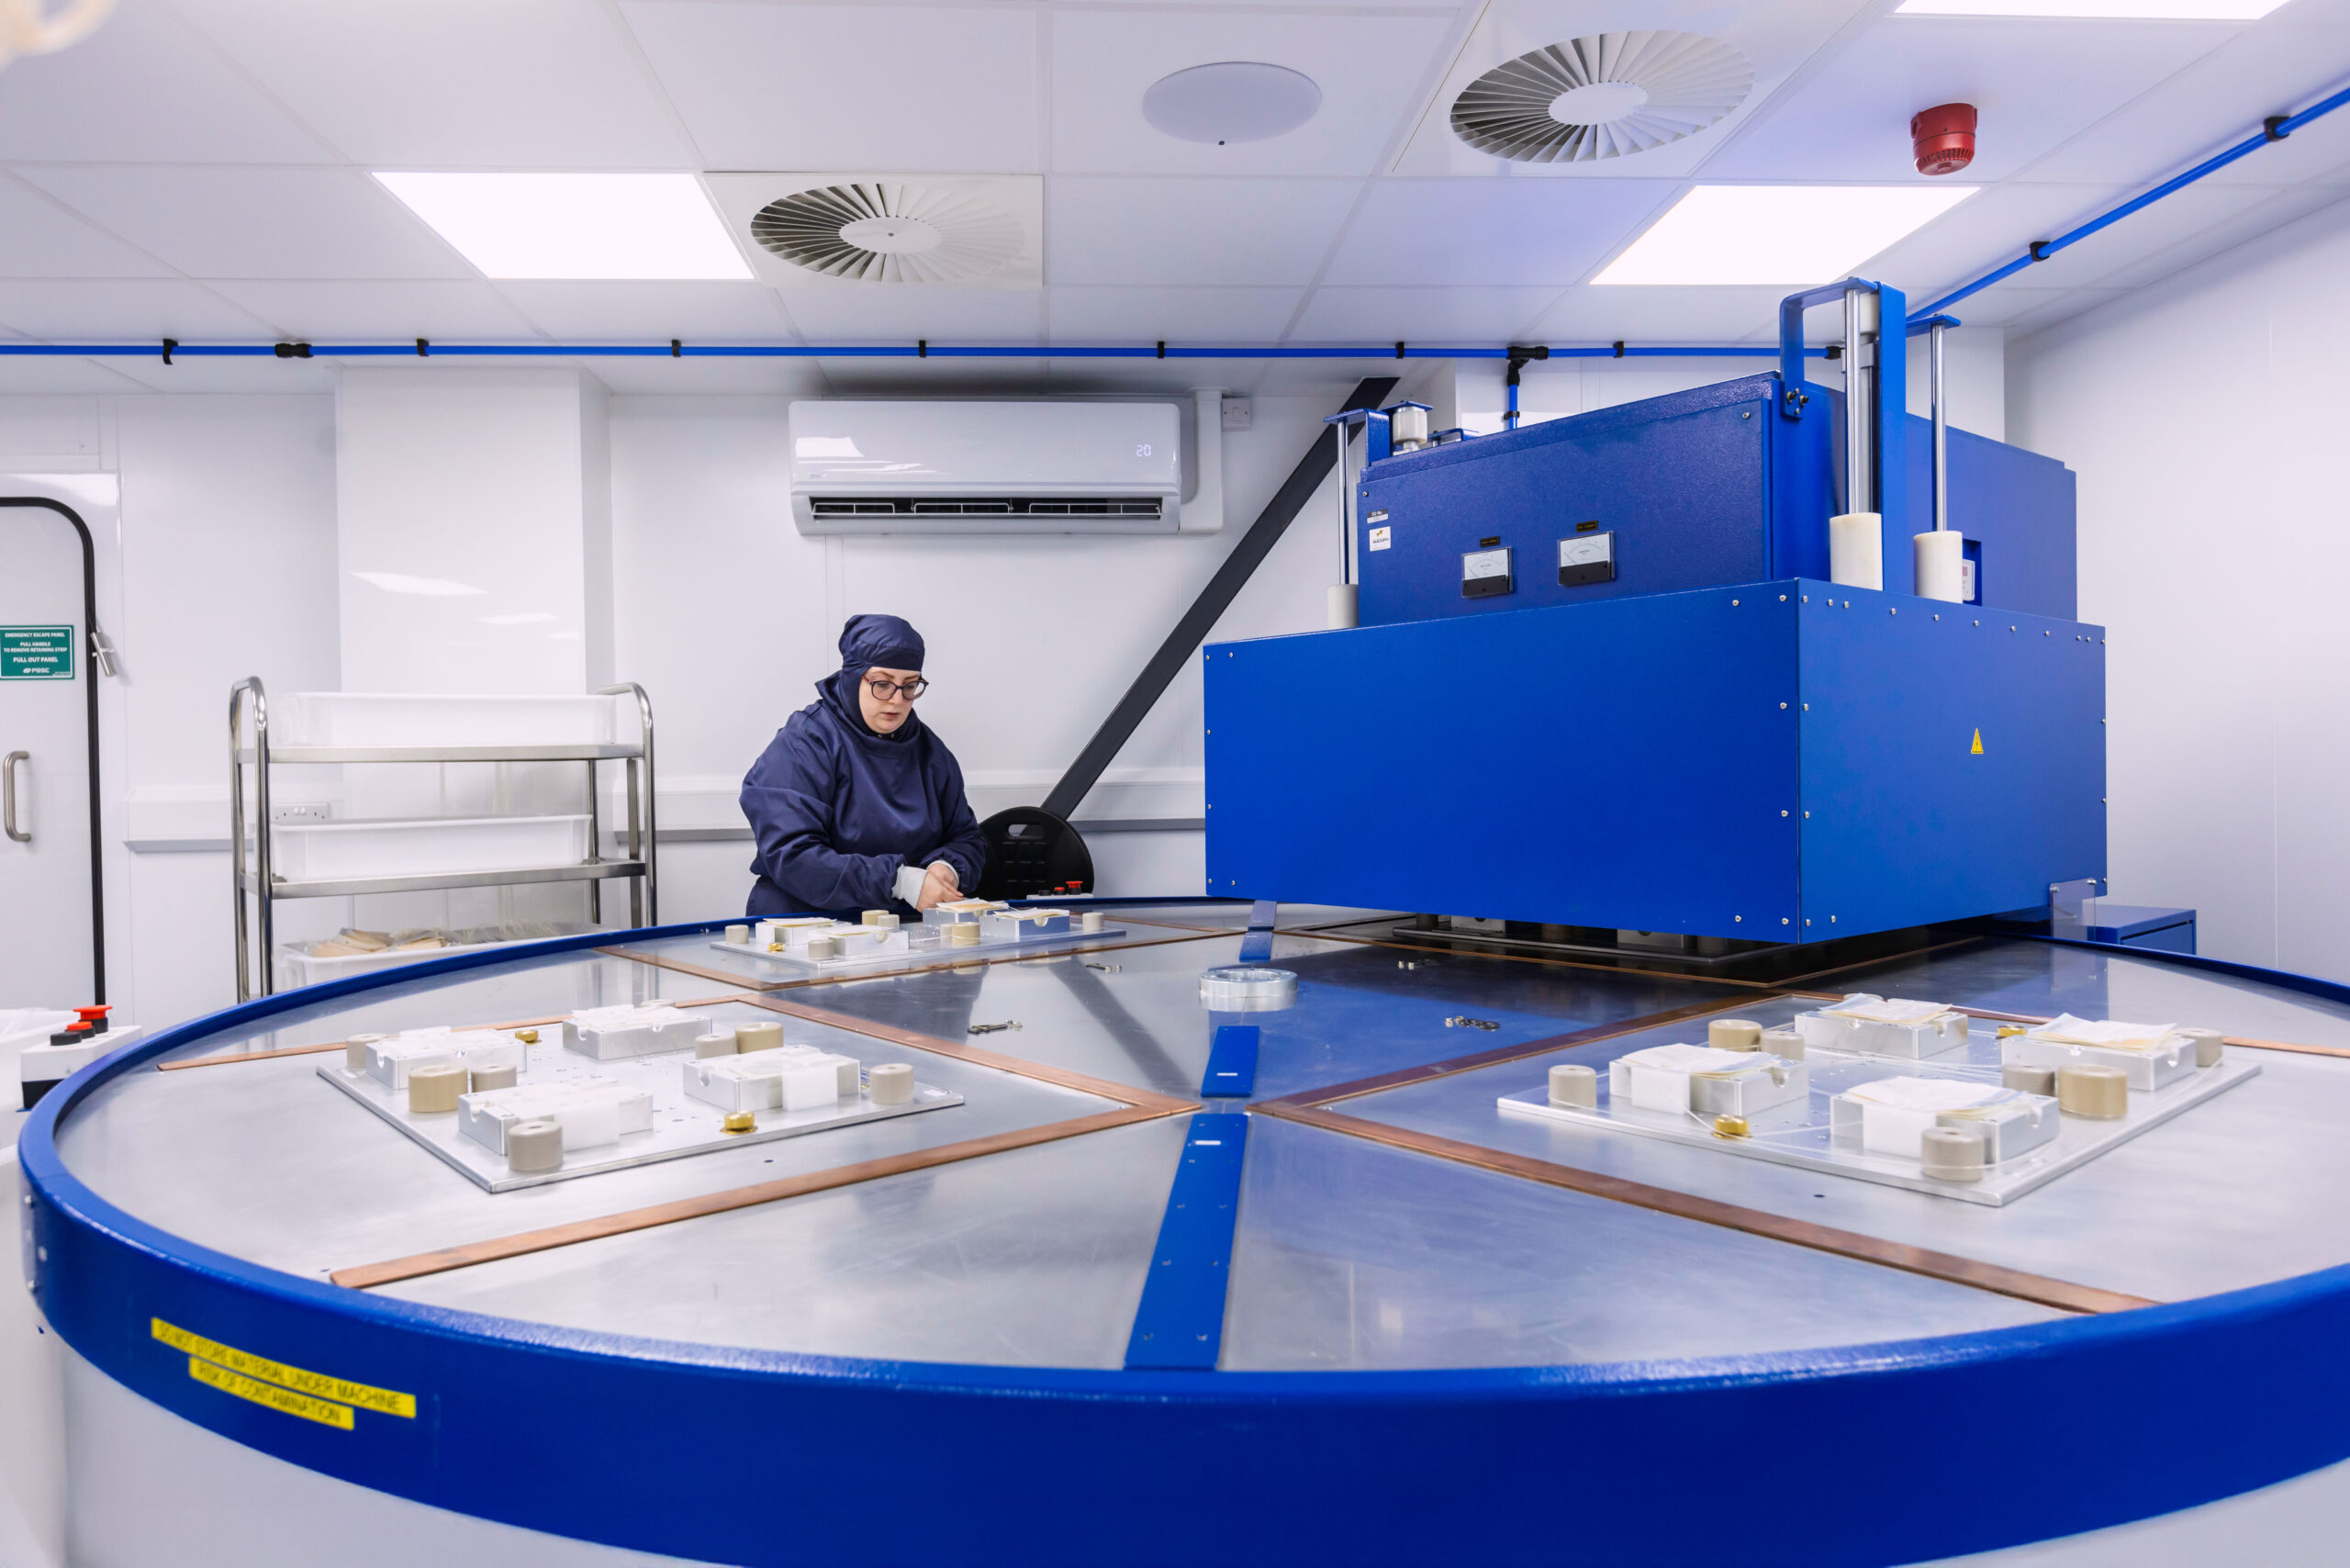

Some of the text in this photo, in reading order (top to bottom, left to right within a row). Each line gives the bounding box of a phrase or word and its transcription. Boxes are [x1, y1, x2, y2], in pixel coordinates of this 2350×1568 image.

[1136, 444, 1151, 456] 20
[170, 1327, 191, 1348] NOT
[196, 1338, 227, 1361] STORE
[230, 1350, 284, 1382] MATERIAL
[291, 1369, 333, 1393] UNDER
[338, 1382, 400, 1410] MACHINE
[197, 1363, 340, 1422] RISK OF CONTAMINATION
